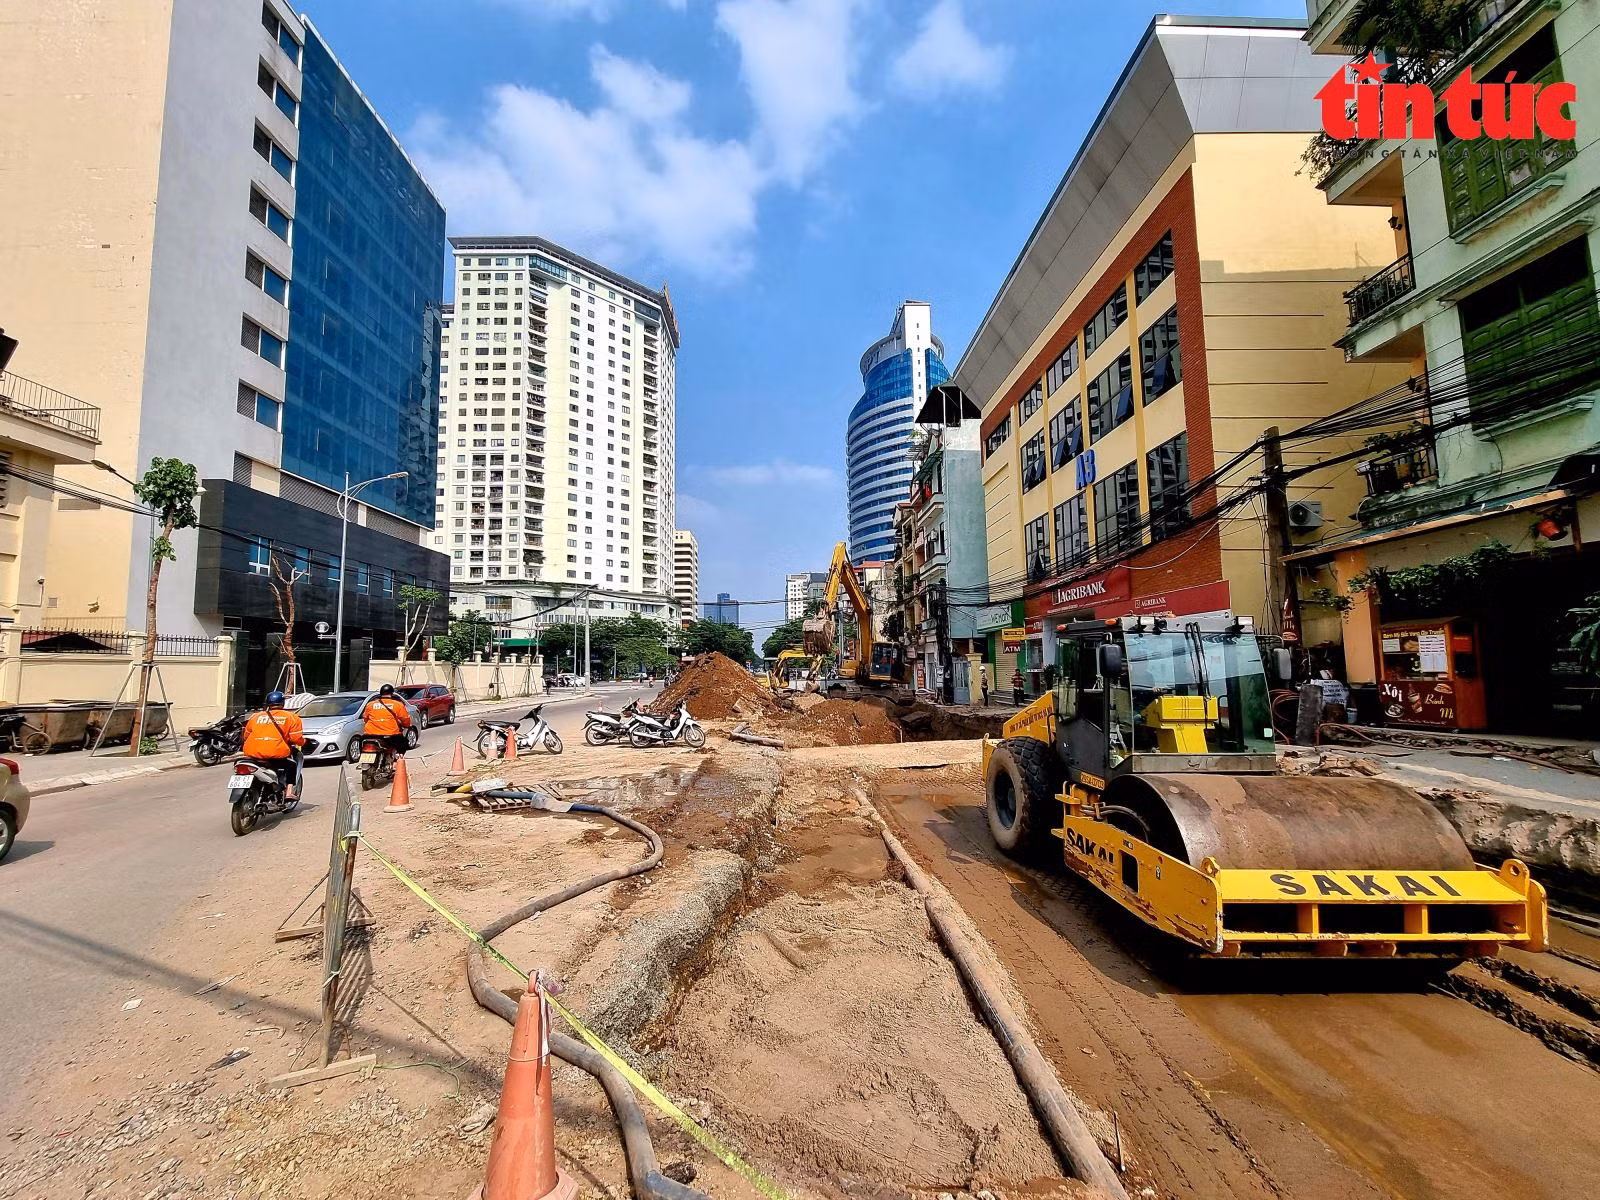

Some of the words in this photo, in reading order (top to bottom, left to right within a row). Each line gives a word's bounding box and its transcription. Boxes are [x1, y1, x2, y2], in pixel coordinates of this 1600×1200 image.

[1076, 449, 1097, 491] A3
[1060, 580, 1107, 603] AGRIBANK
[1382, 683, 1403, 702] Xôi
[1066, 827, 1114, 865] SAKAI
[1270, 873, 1462, 897] SAKAI
